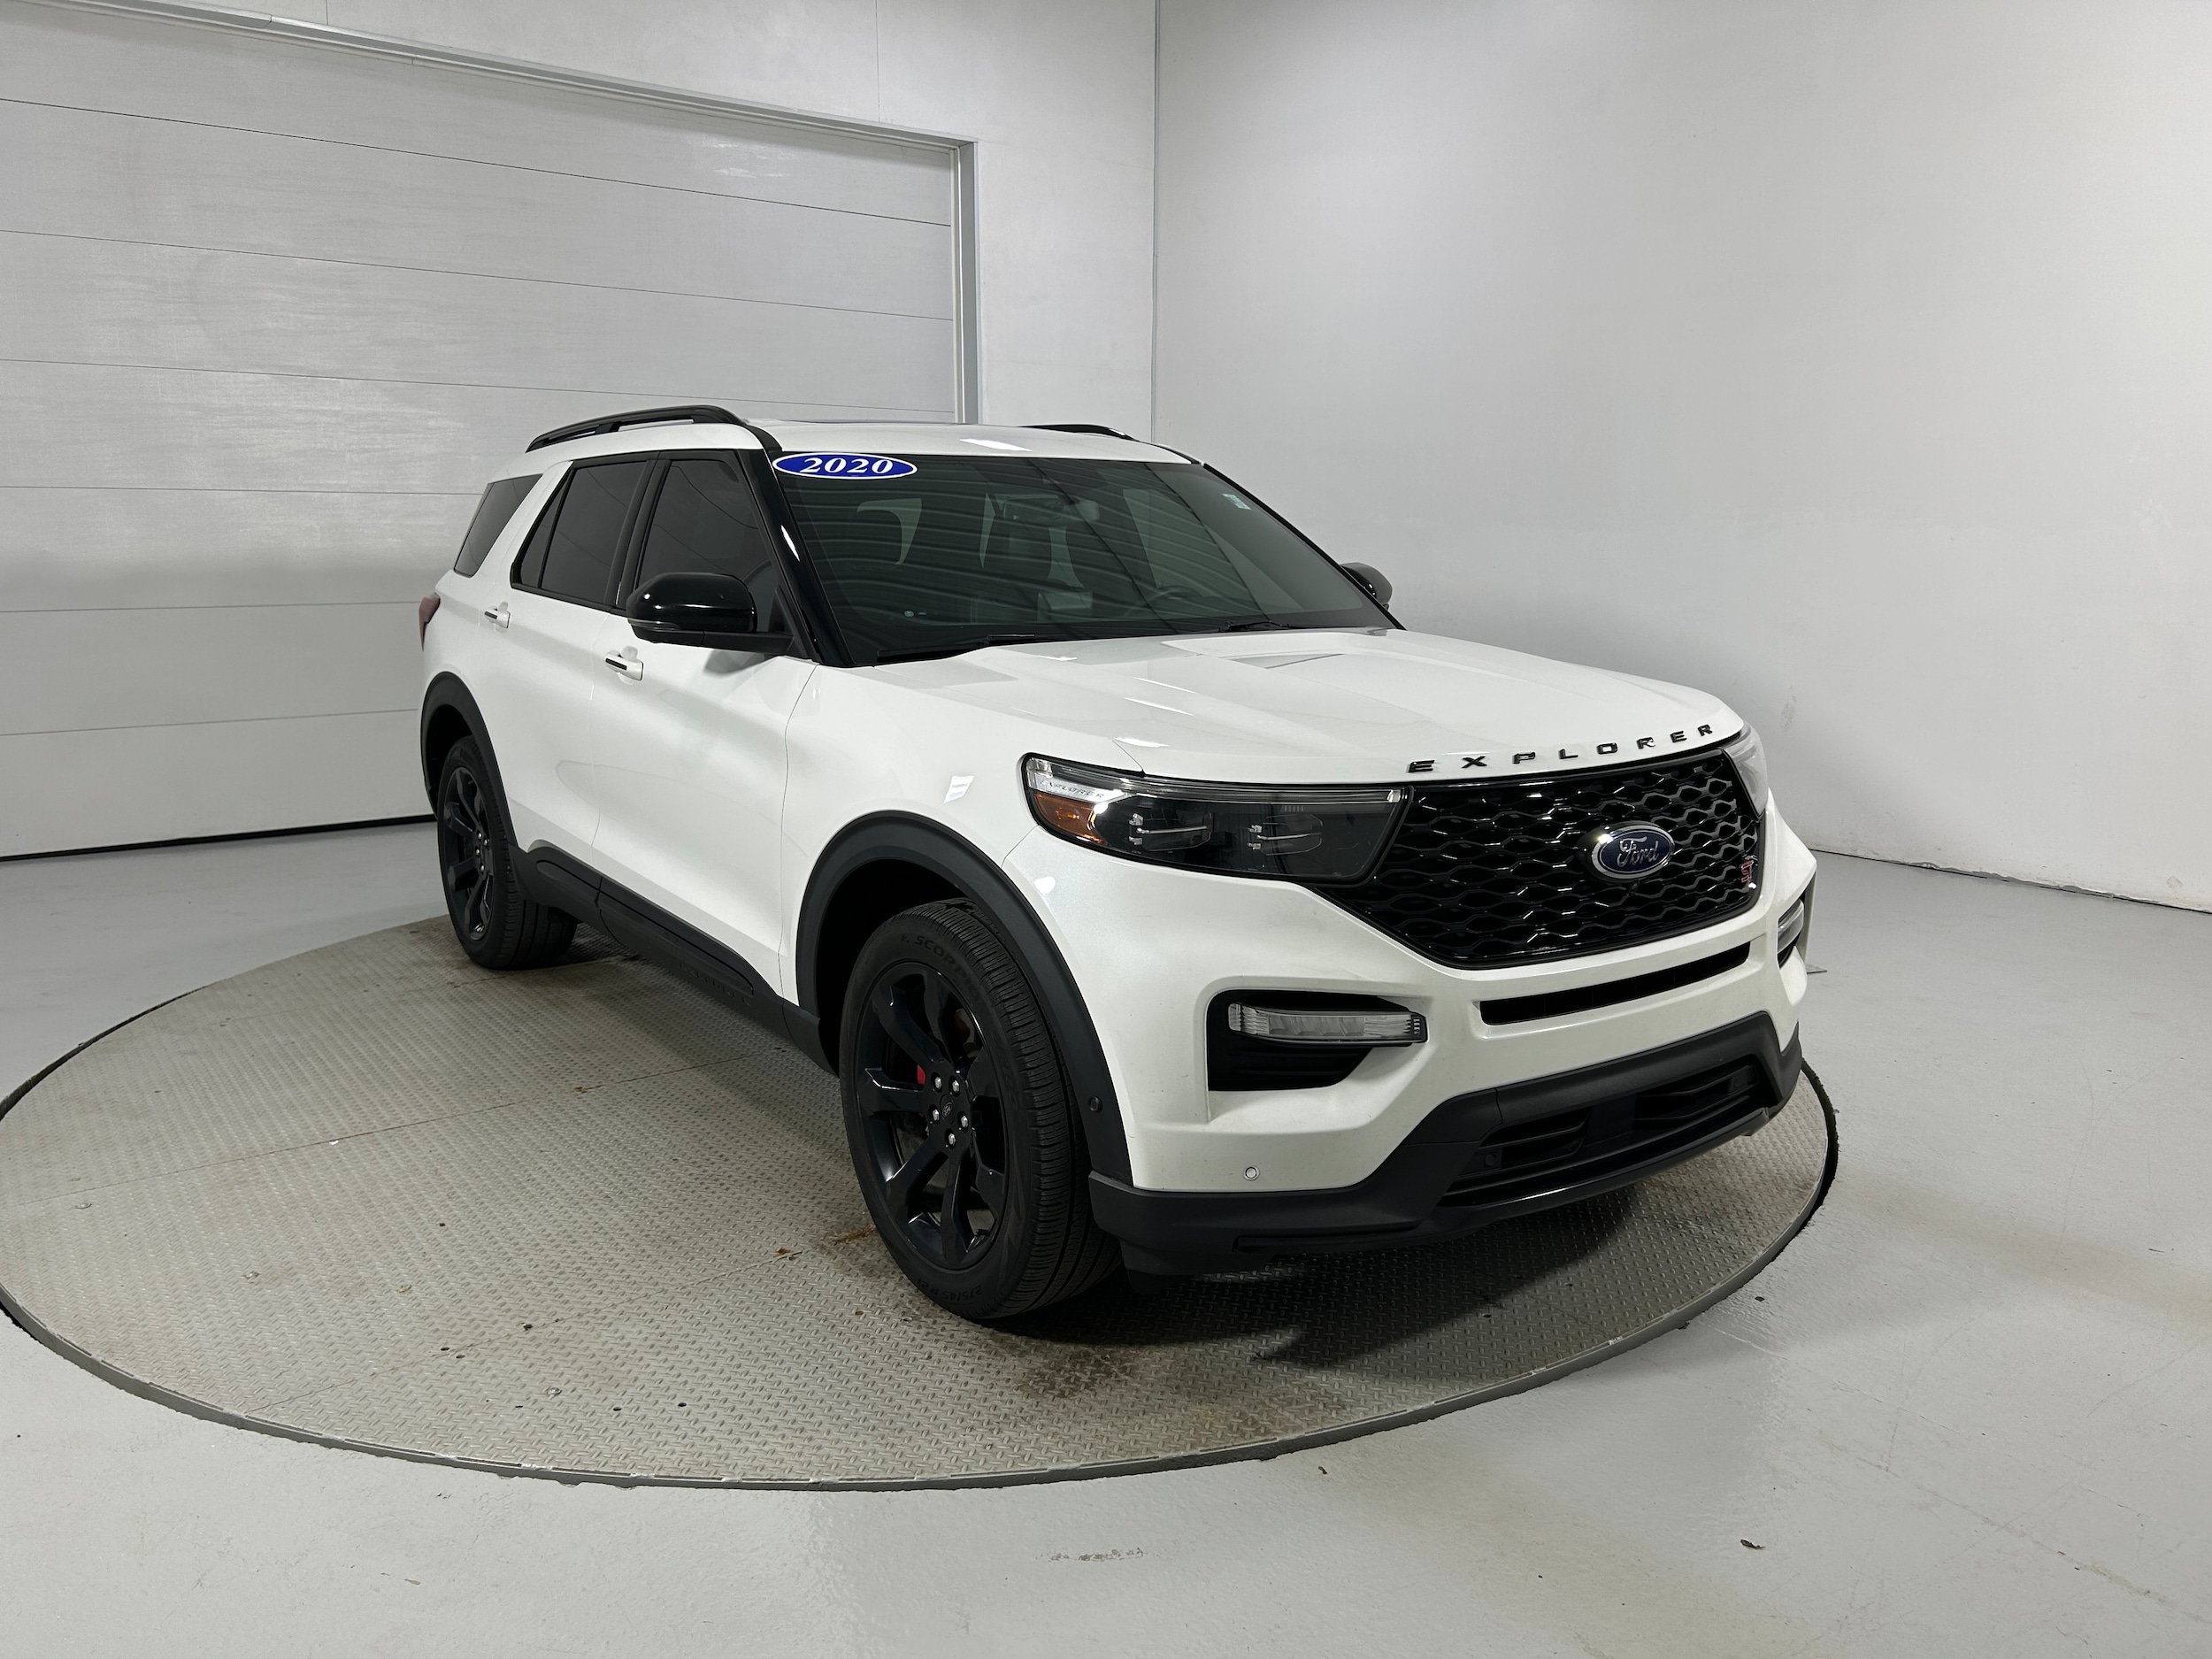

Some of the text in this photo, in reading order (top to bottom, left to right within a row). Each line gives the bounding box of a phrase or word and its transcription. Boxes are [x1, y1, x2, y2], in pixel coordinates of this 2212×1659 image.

[799, 457, 894, 474] 2020
[1407, 723, 1714, 773] EXPLORER
[1617, 835, 1660, 867] Ford
